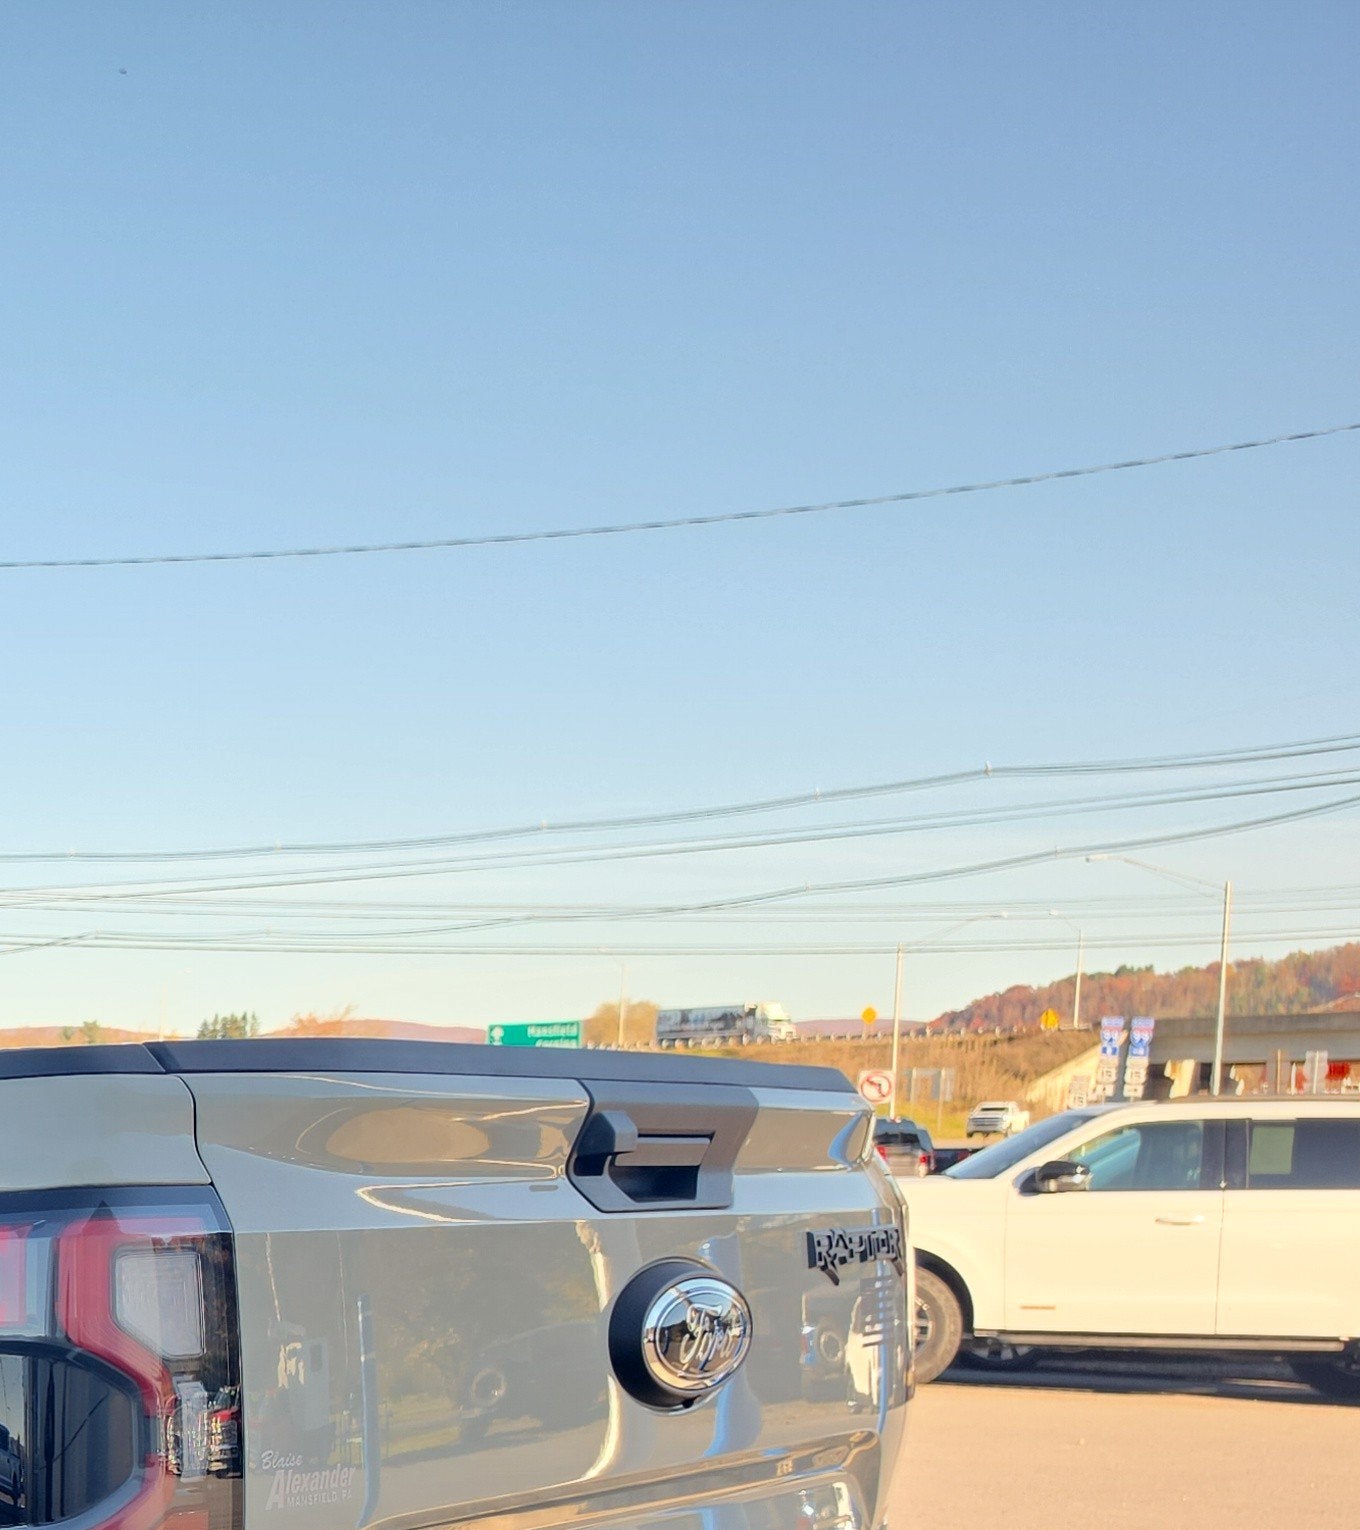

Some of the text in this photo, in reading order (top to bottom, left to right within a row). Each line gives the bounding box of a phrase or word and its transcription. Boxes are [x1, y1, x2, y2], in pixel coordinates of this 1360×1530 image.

[806, 1225, 904, 1286] RAPTOR
[679, 1303, 744, 1372] Ford
[260, 1450, 304, 1470] Blaise
[265, 1463, 357, 1511] Alexander
